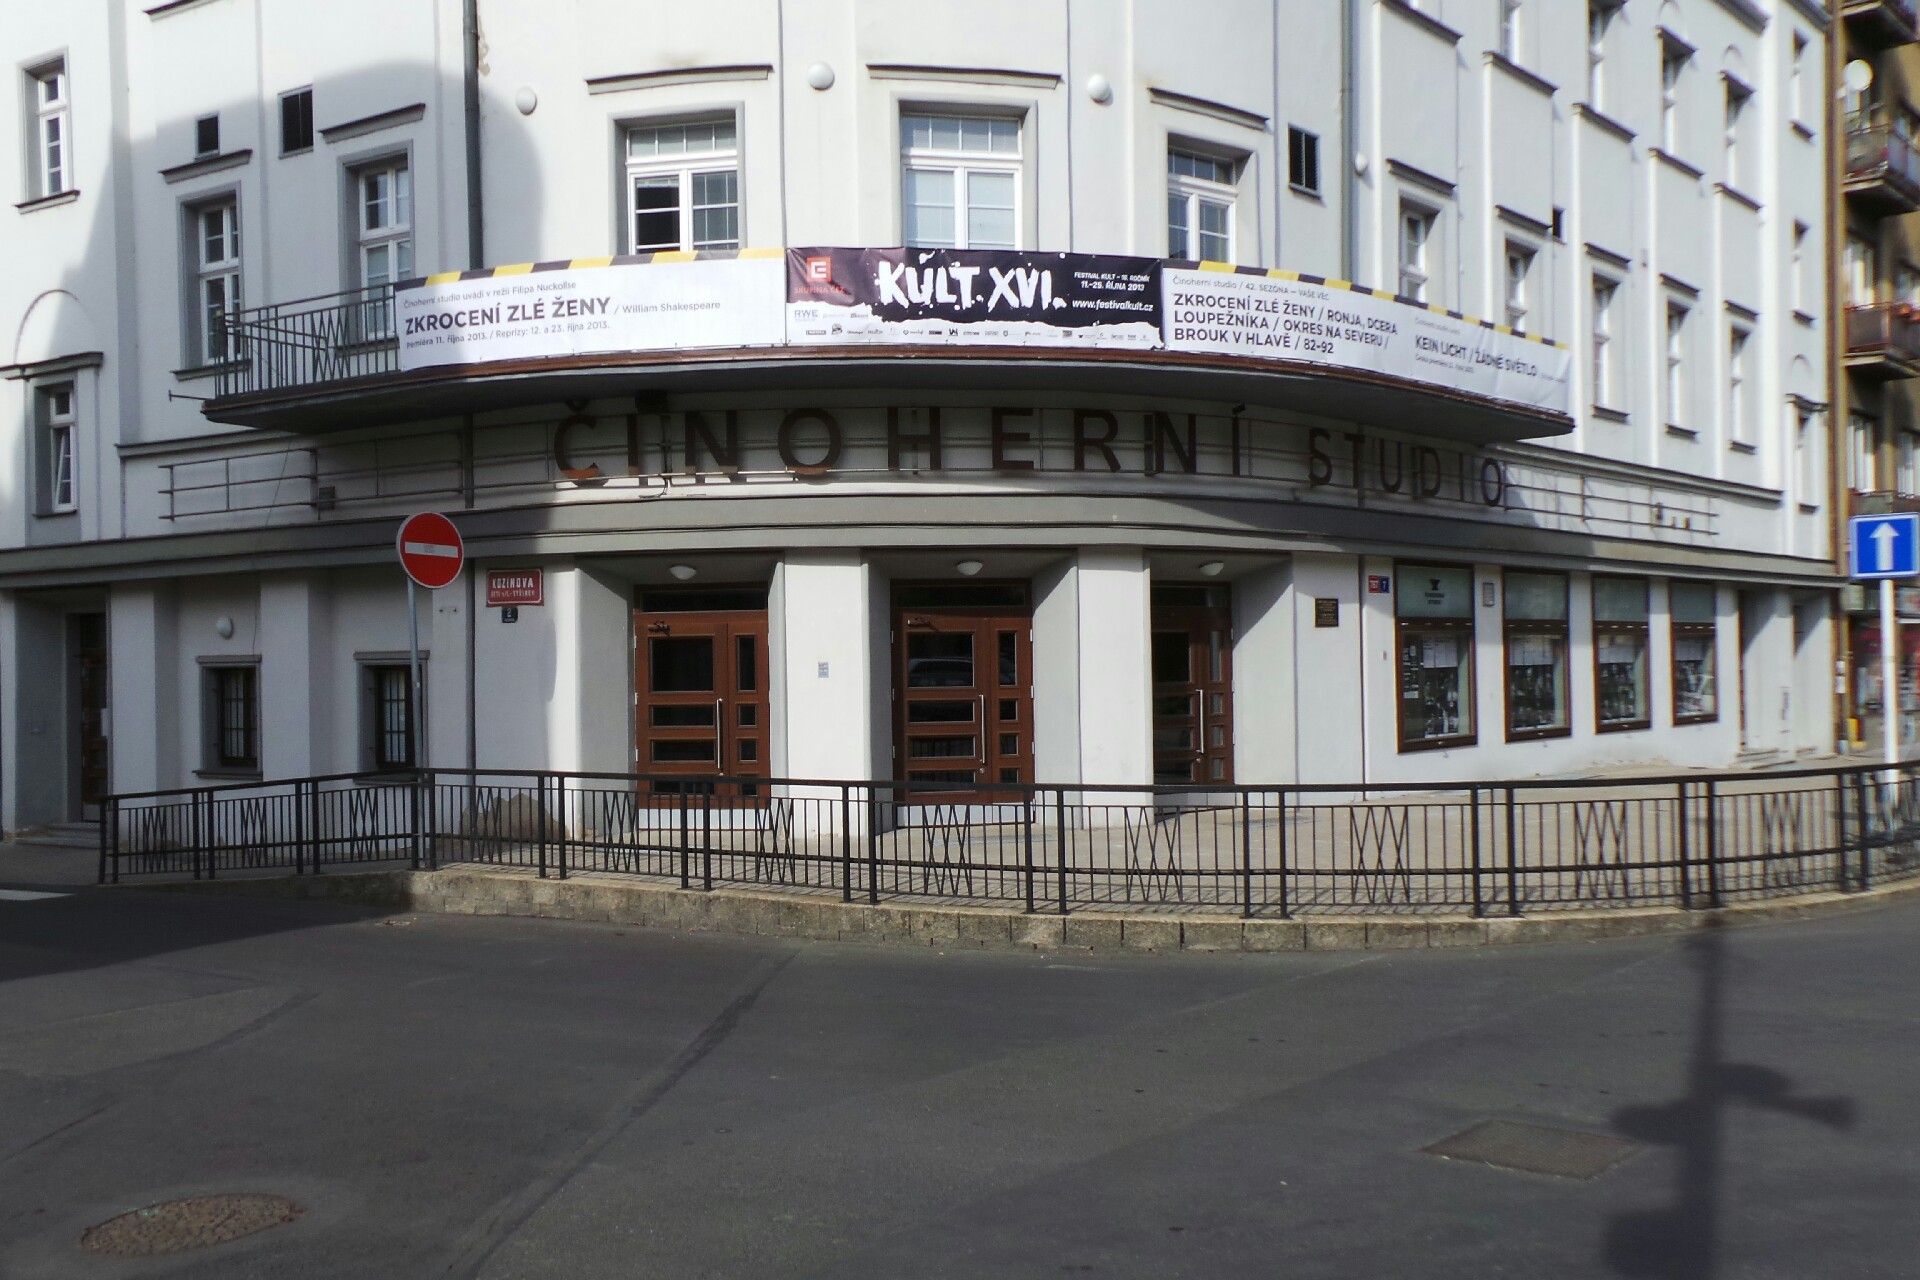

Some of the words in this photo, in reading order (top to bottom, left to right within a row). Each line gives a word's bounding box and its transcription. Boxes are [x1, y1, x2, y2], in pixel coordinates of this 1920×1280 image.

[1074, 272, 1099, 280] FESTIVAL
[1128, 283, 1145, 292] 2013
[1173, 275, 1211, 286] Činoherní
[1213, 280, 1237, 288] studio
[1259, 283, 1289, 294] SEZÓNA
[403, 297, 436, 309] Činoherní
[437, 294, 461, 304] studio
[463, 291, 485, 300] uvádí
[493, 287, 510, 296] režii
[512, 286, 534, 295] Filipa
[988, 267, 1067, 313] XVI.
[405, 302, 500, 336] ZKROCENÍ
[507, 298, 545, 323] ZLÉ
[552, 296, 610, 318] ŽENY
[622, 304, 658, 314] William
[660, 301, 721, 313] Shakespeare
[794, 309, 819, 318] RWE
[1072, 299, 1154, 312] www.festivalkult.cz
[1173, 293, 1250, 311] ZKROCENÍ
[1255, 299, 1279, 314] ZLÉ
[1283, 300, 1315, 319] ŽENY
[1318, 307, 1324, 321] /
[1327, 309, 1365, 329] RONJA,
[1367, 317, 1398, 335] DCERA
[447, 335, 465, 344] října
[467, 333, 488, 341] 2013.
[496, 327, 528, 339] Reprízy:
[567, 323, 584, 333] října
[1174, 310, 1269, 329] LOUPEŽNÍKA
[1272, 317, 1280, 332] /
[1283, 319, 1323, 336] OKRES
[1325, 325, 1342, 339] NA
[1345, 329, 1382, 346] SEVERU
[1174, 328, 1228, 343] BROUK
[1233, 331, 1242, 344] V
[1246, 332, 1291, 348] HLAVĚ
[1294, 335, 1301, 350] /
[1303, 338, 1334, 354] 82-92
[1415, 335, 1438, 353] KEIN
[1440, 342, 1467, 360] LICHT
[1505, 357, 1538, 376] SVĚTLO
[1309, 427, 1503, 507] STUDIO
[493, 578, 533, 588] KOZINOVA
